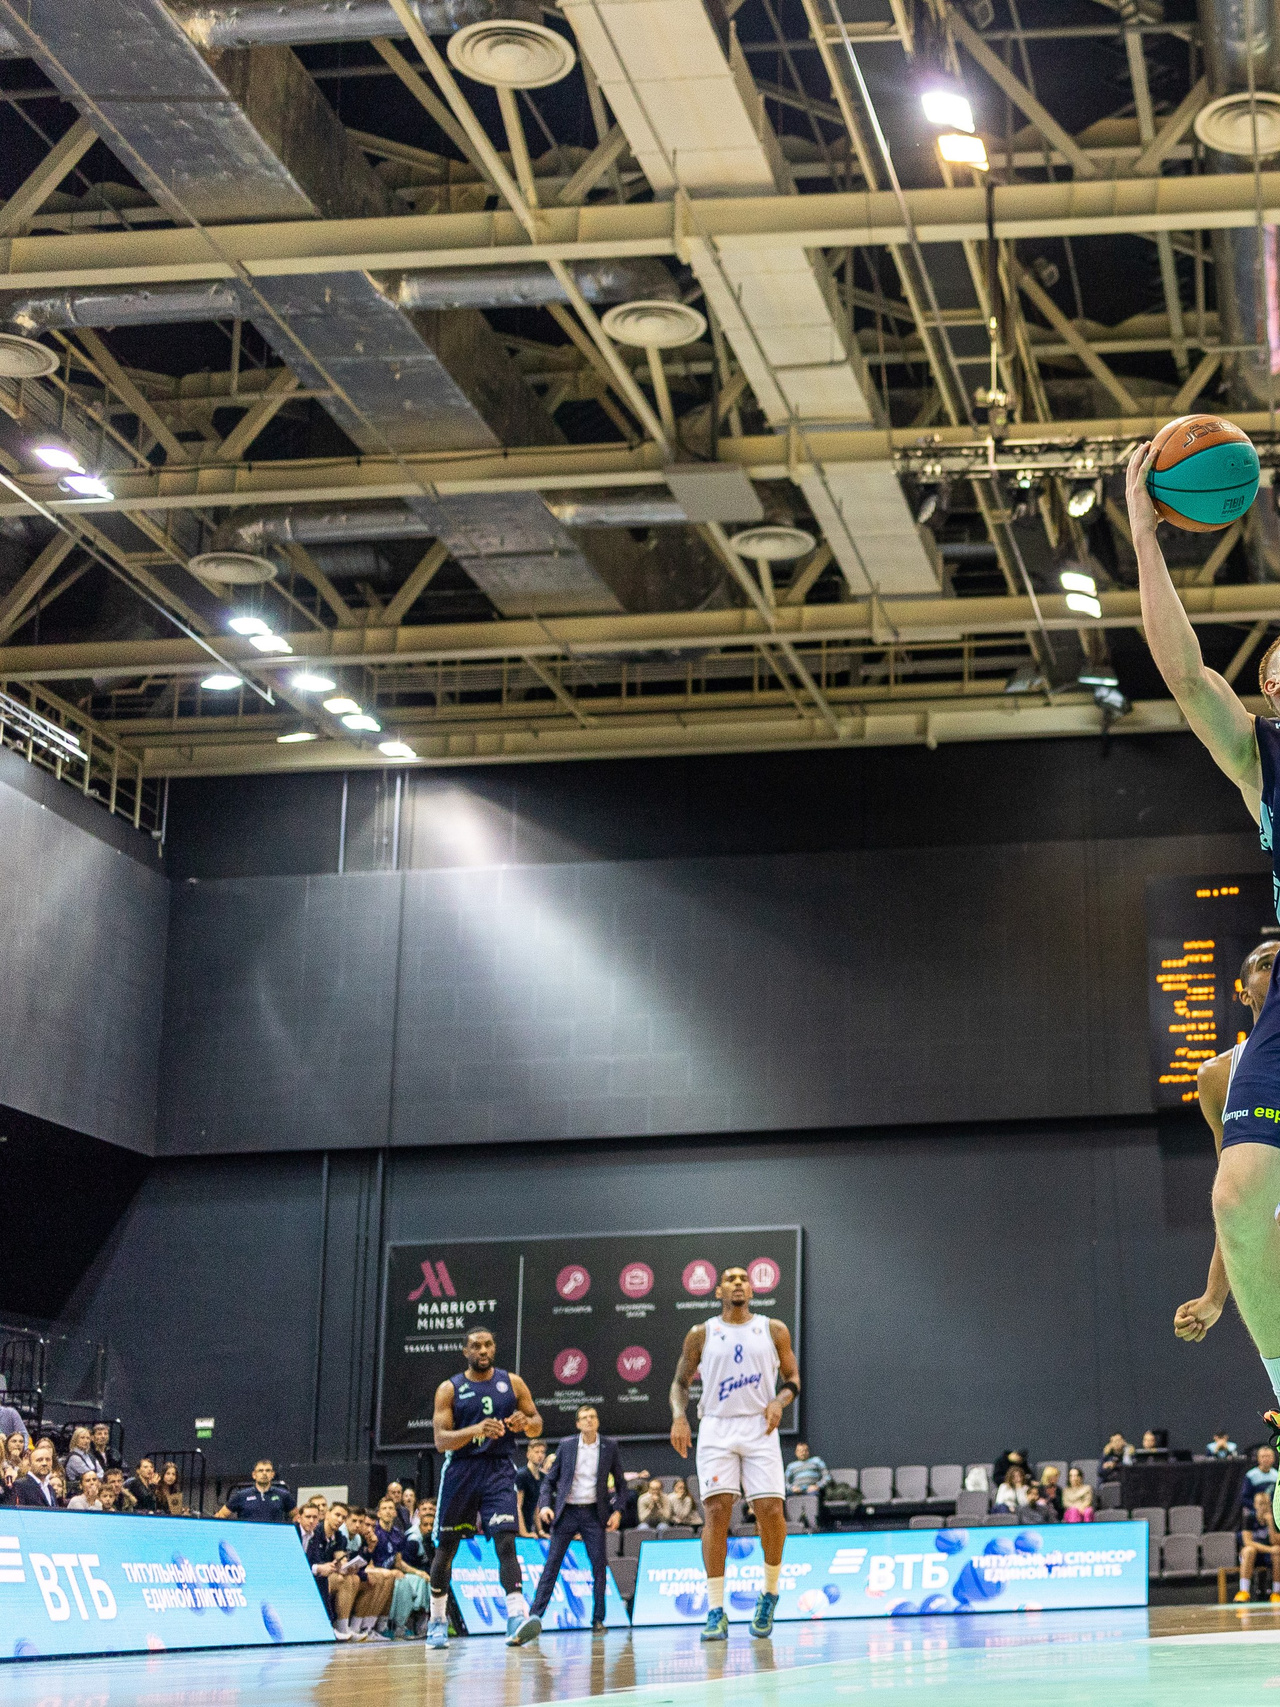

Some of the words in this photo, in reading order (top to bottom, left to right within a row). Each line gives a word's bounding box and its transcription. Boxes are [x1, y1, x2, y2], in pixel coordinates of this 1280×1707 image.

[418, 1300, 497, 1315] MARRIOTT
[417, 1316, 465, 1331] MINSK
[623, 1356, 647, 1370] VIP
[734, 1344, 744, 1364] 8
[718, 1373, 762, 1402] Enisey
[481, 1396, 494, 1415] 3
[971, 1550, 1063, 1569] ТИТУЛЬНЫЙ
[1064, 1549, 1137, 1565] СПОНСОР
[121, 1558, 197, 1583] ТИТУЛЬНЫЙ
[195, 1563, 247, 1583] СПОНСОР
[868, 1552, 950, 1592] ВТБ
[983, 1566, 1050, 1583] ЕДИНОЙ
[1093, 1563, 1122, 1577] ВТБ
[28, 1553, 118, 1622] ВТБ
[142, 1583, 196, 1612] ЕДИНОЙ
[193, 1588, 228, 1609] ЛИГИ
[223, 1587, 248, 1608] ВТБ
